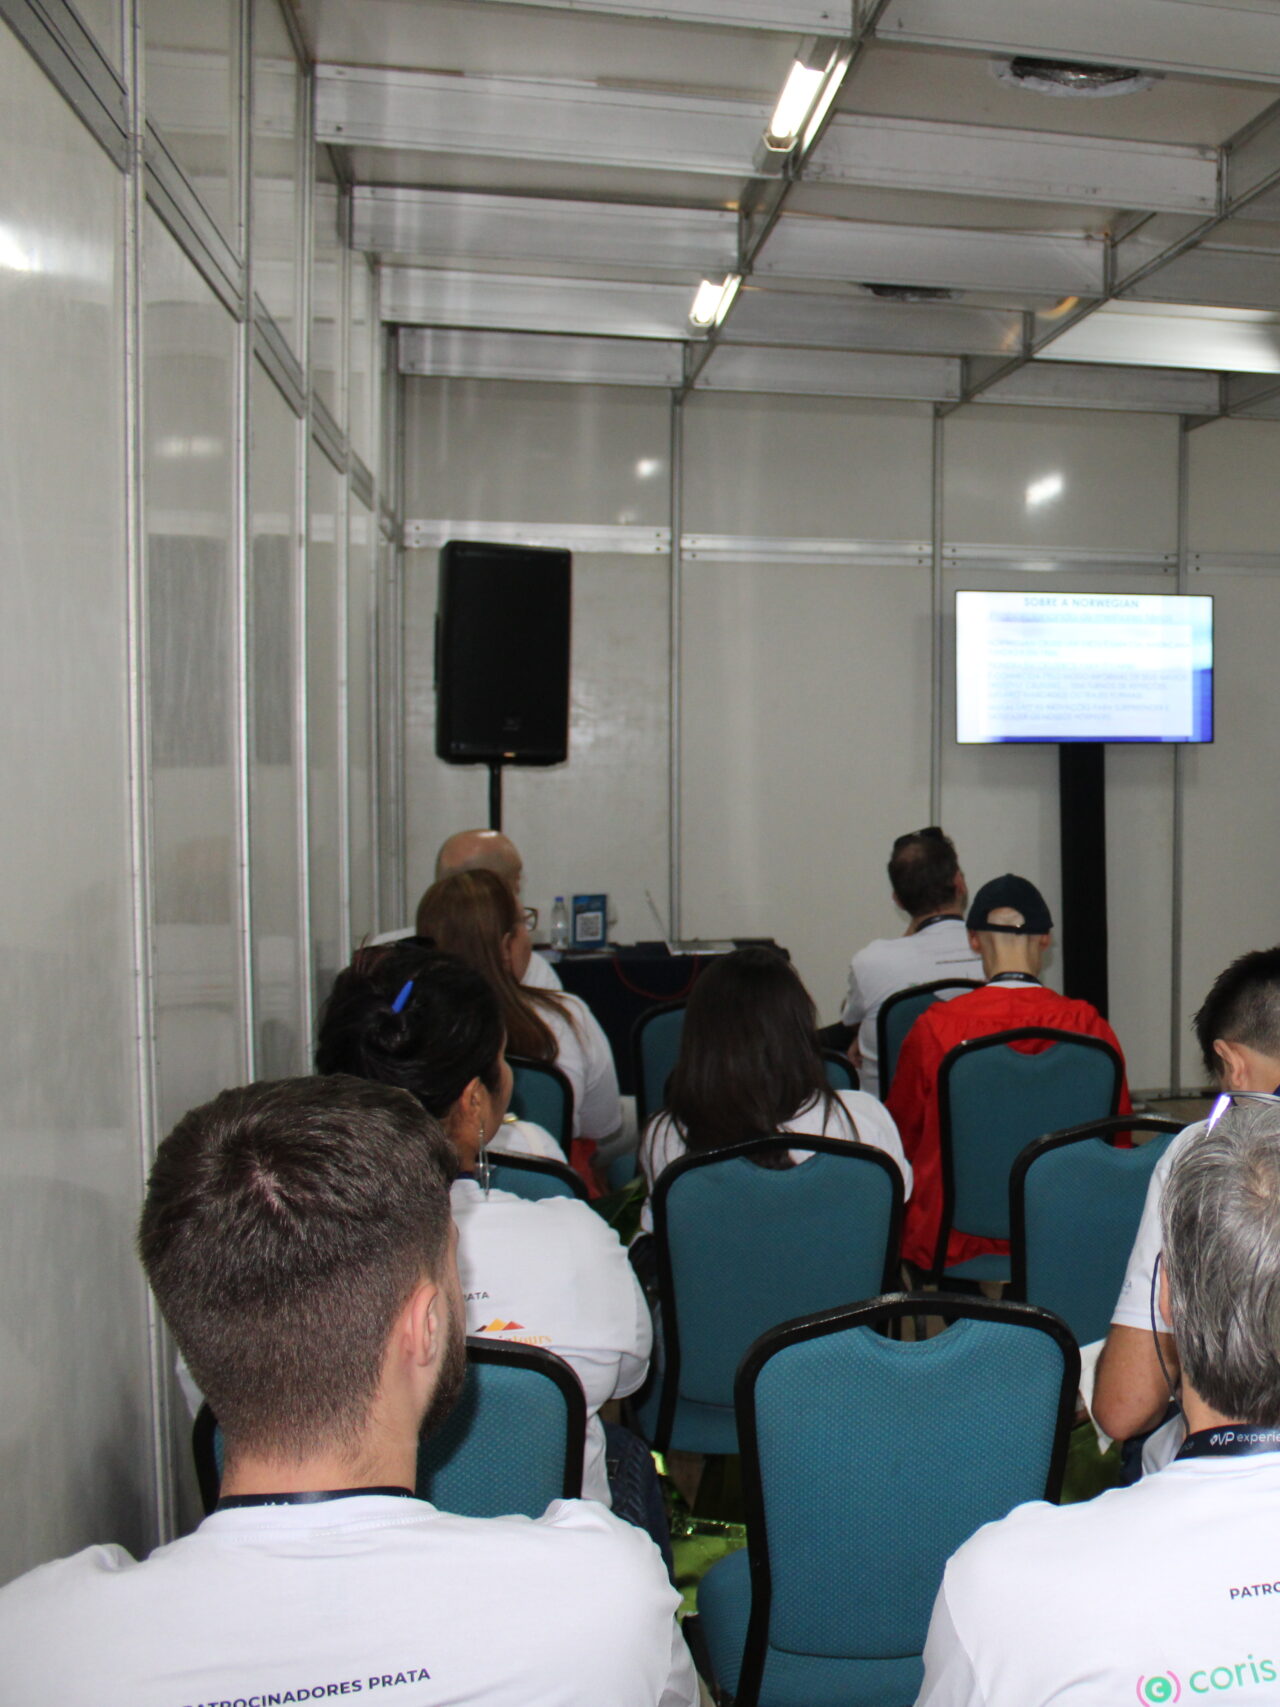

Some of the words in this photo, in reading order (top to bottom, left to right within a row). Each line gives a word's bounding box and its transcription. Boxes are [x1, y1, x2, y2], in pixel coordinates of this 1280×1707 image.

[1024, 597, 1057, 608] SOBRE
[1061, 598, 1069, 608] A
[1072, 598, 1140, 609] NORWEGIAN
[463, 1291, 489, 1301] ATA
[1189, 1653, 1277, 1693] coris
[182, 1679, 363, 1707] OCINADORES
[368, 1668, 431, 1690] PRATA
